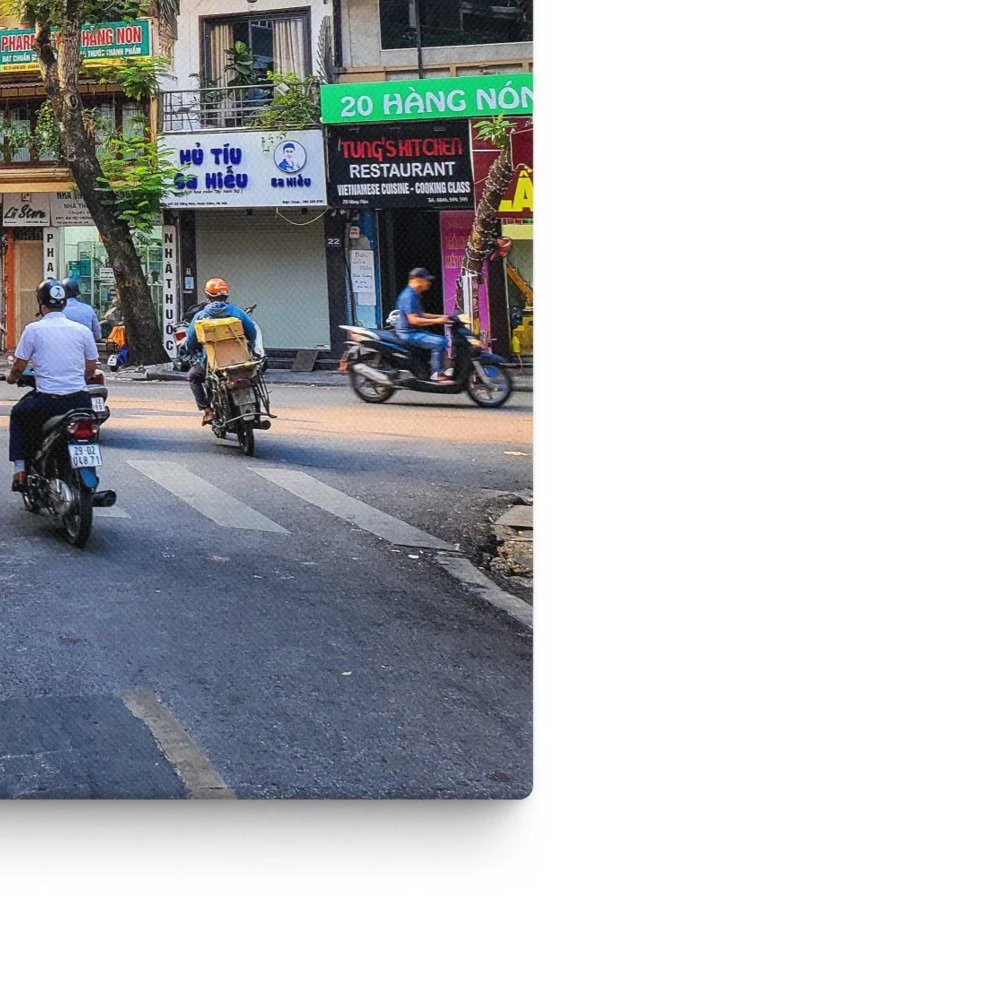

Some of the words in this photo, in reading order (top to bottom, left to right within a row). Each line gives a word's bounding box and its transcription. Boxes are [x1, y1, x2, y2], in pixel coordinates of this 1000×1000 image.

[341, 95, 373, 117] 20
[383, 86, 467, 115] HÀNG
[210, 143, 242, 166] TÍU
[350, 162, 456, 179] RESTAURANT
[337, 184, 379, 196] VIETNAMESE
[381, 183, 410, 195] CUISINE
[415, 182, 447, 194] COOKING
[448, 181, 471, 193] CLASS
[327, 238, 340, 246] 22
